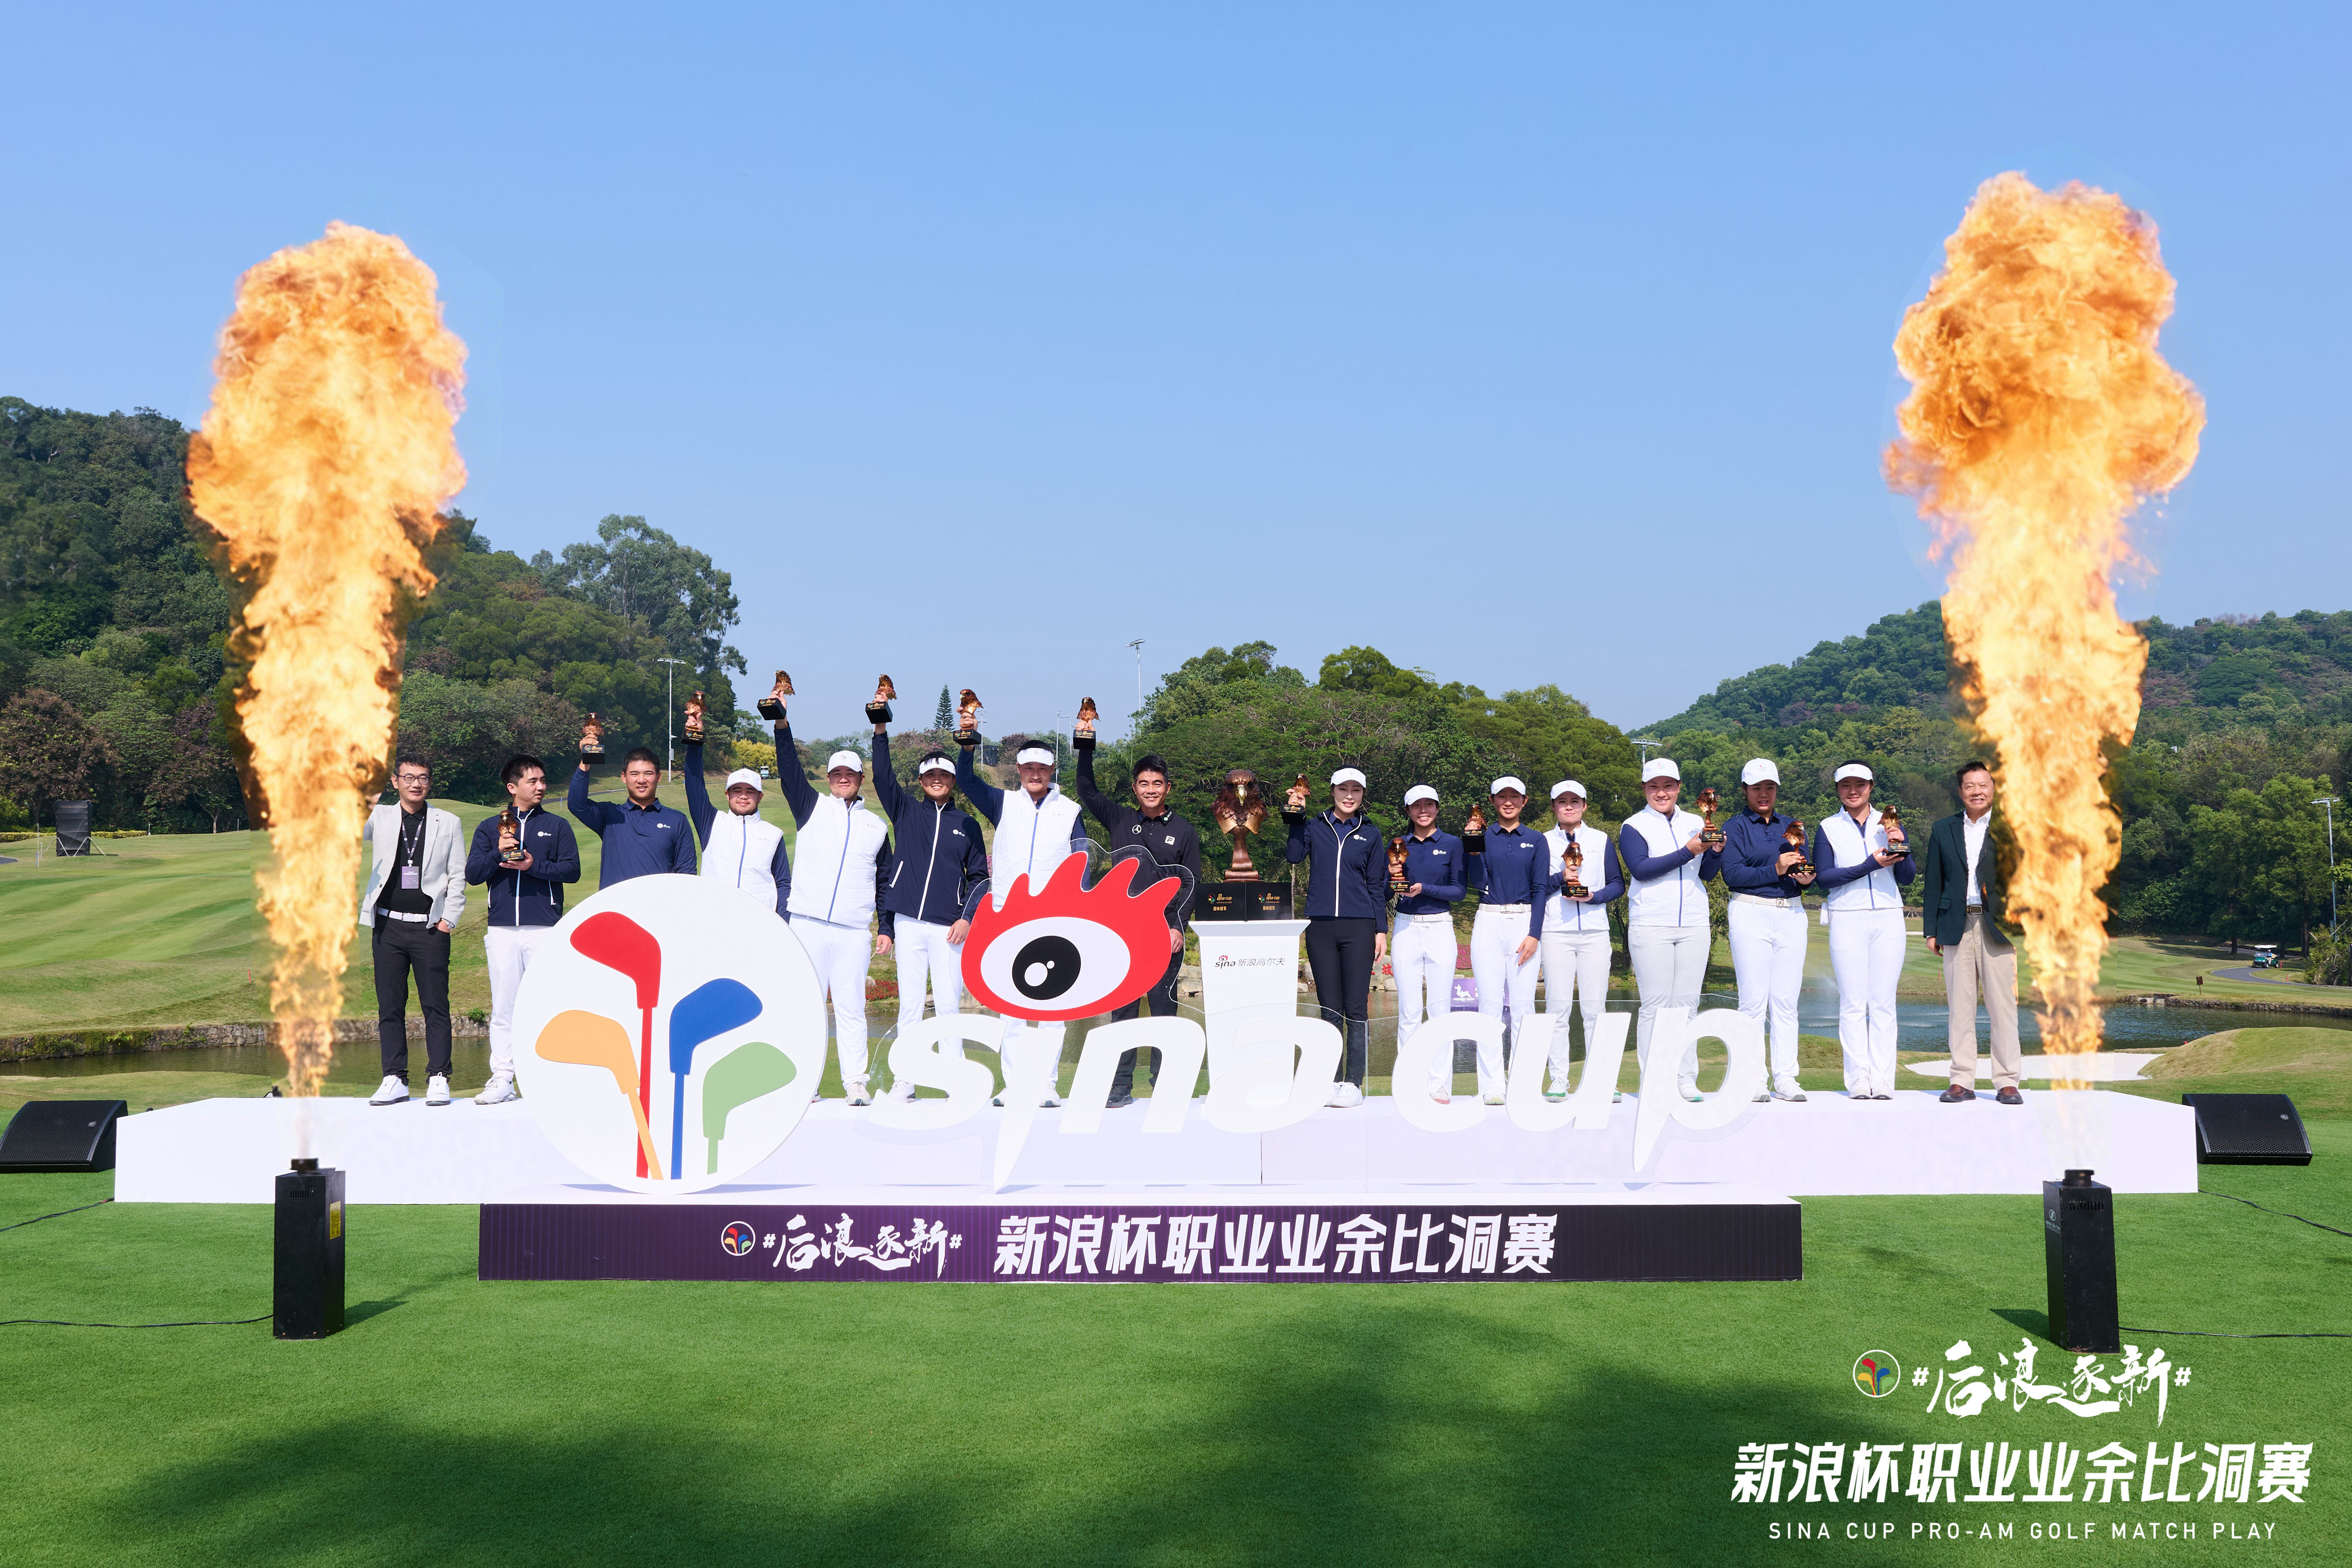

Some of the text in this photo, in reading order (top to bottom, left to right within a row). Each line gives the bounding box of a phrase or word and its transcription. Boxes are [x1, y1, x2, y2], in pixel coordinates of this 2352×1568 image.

[1215, 958, 1285, 970] sina 新浪高尔夫
[868, 1007, 1765, 1191] sina cup
[993, 1213, 1558, 1275] 新浪杯职业业余比洞赛
